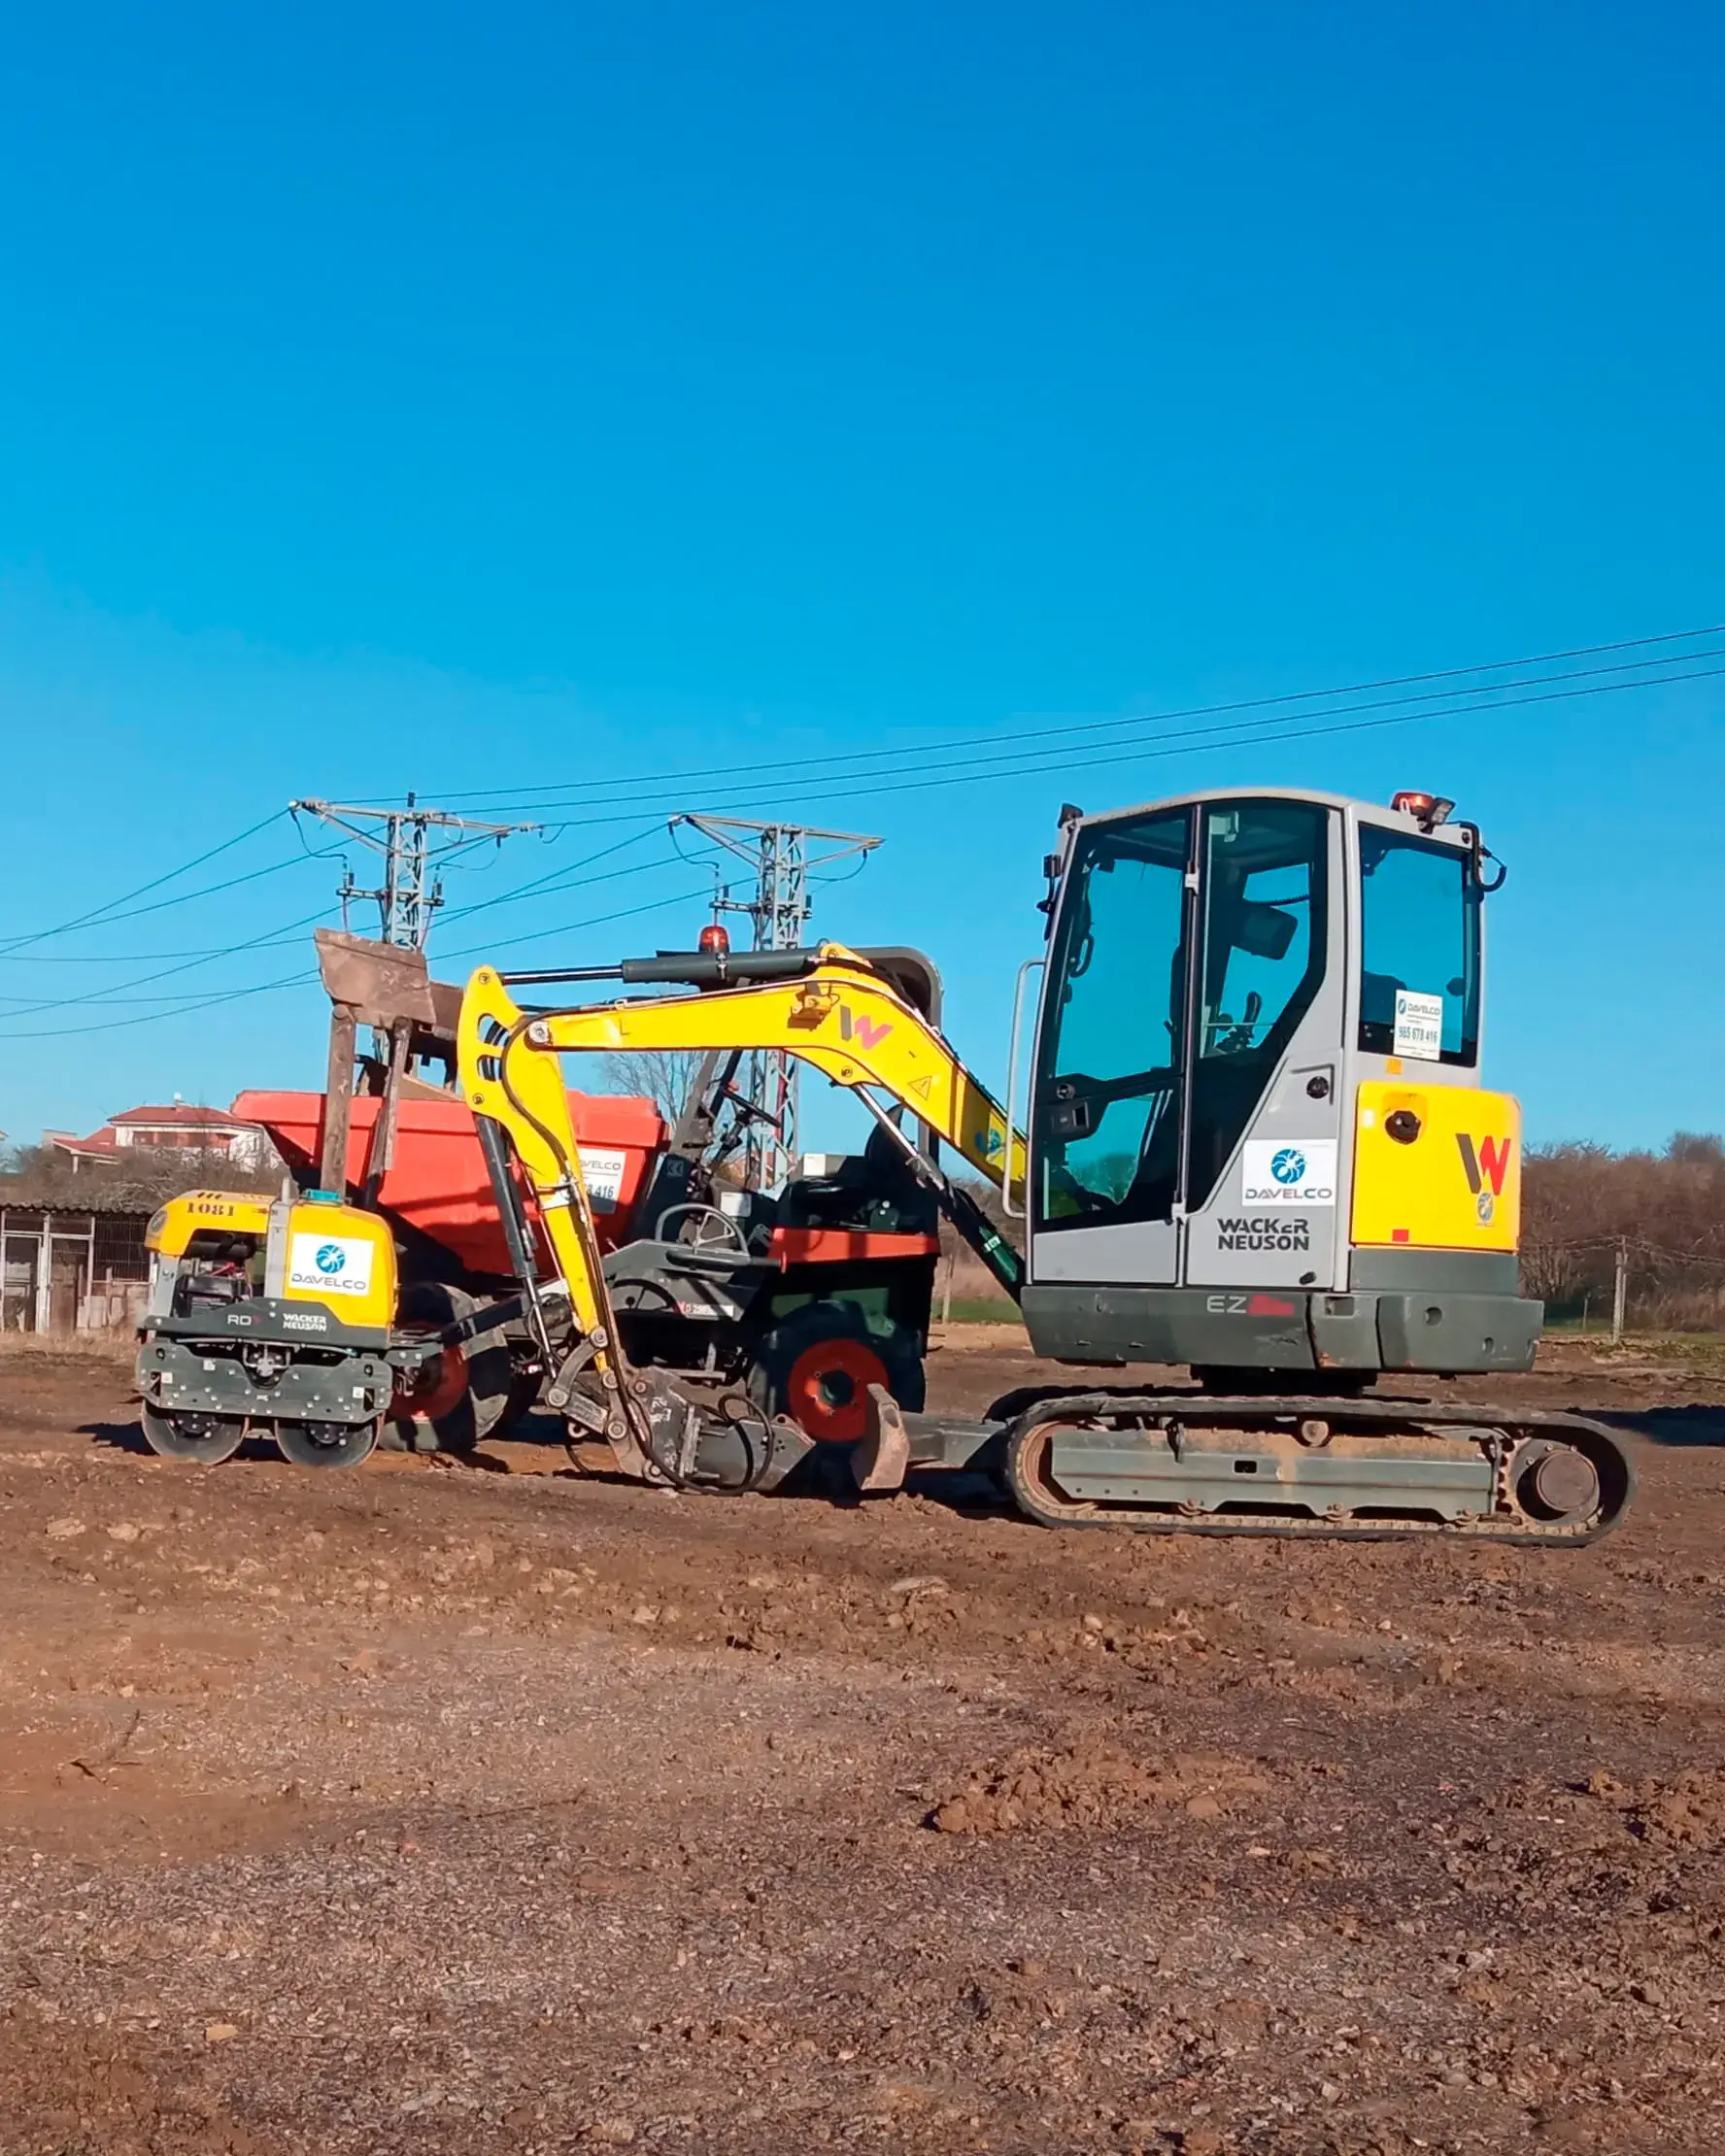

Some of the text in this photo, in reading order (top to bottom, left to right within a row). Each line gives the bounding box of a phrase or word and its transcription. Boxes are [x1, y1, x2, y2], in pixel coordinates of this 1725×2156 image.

[1407, 1003, 1440, 1015] DAVELCO
[594, 1184, 615, 1198] 416
[1244, 1188, 1334, 1200] DAVELCO
[187, 1202, 234, 1216] 1081
[1217, 1218, 1310, 1234] WACKER
[1217, 1235, 1310, 1251] NEUSON
[291, 1273, 366, 1290] DAVELCO
[226, 1314, 253, 1326] RD
[283, 1312, 327, 1323] WACKER
[283, 1321, 327, 1332] NEUSON
